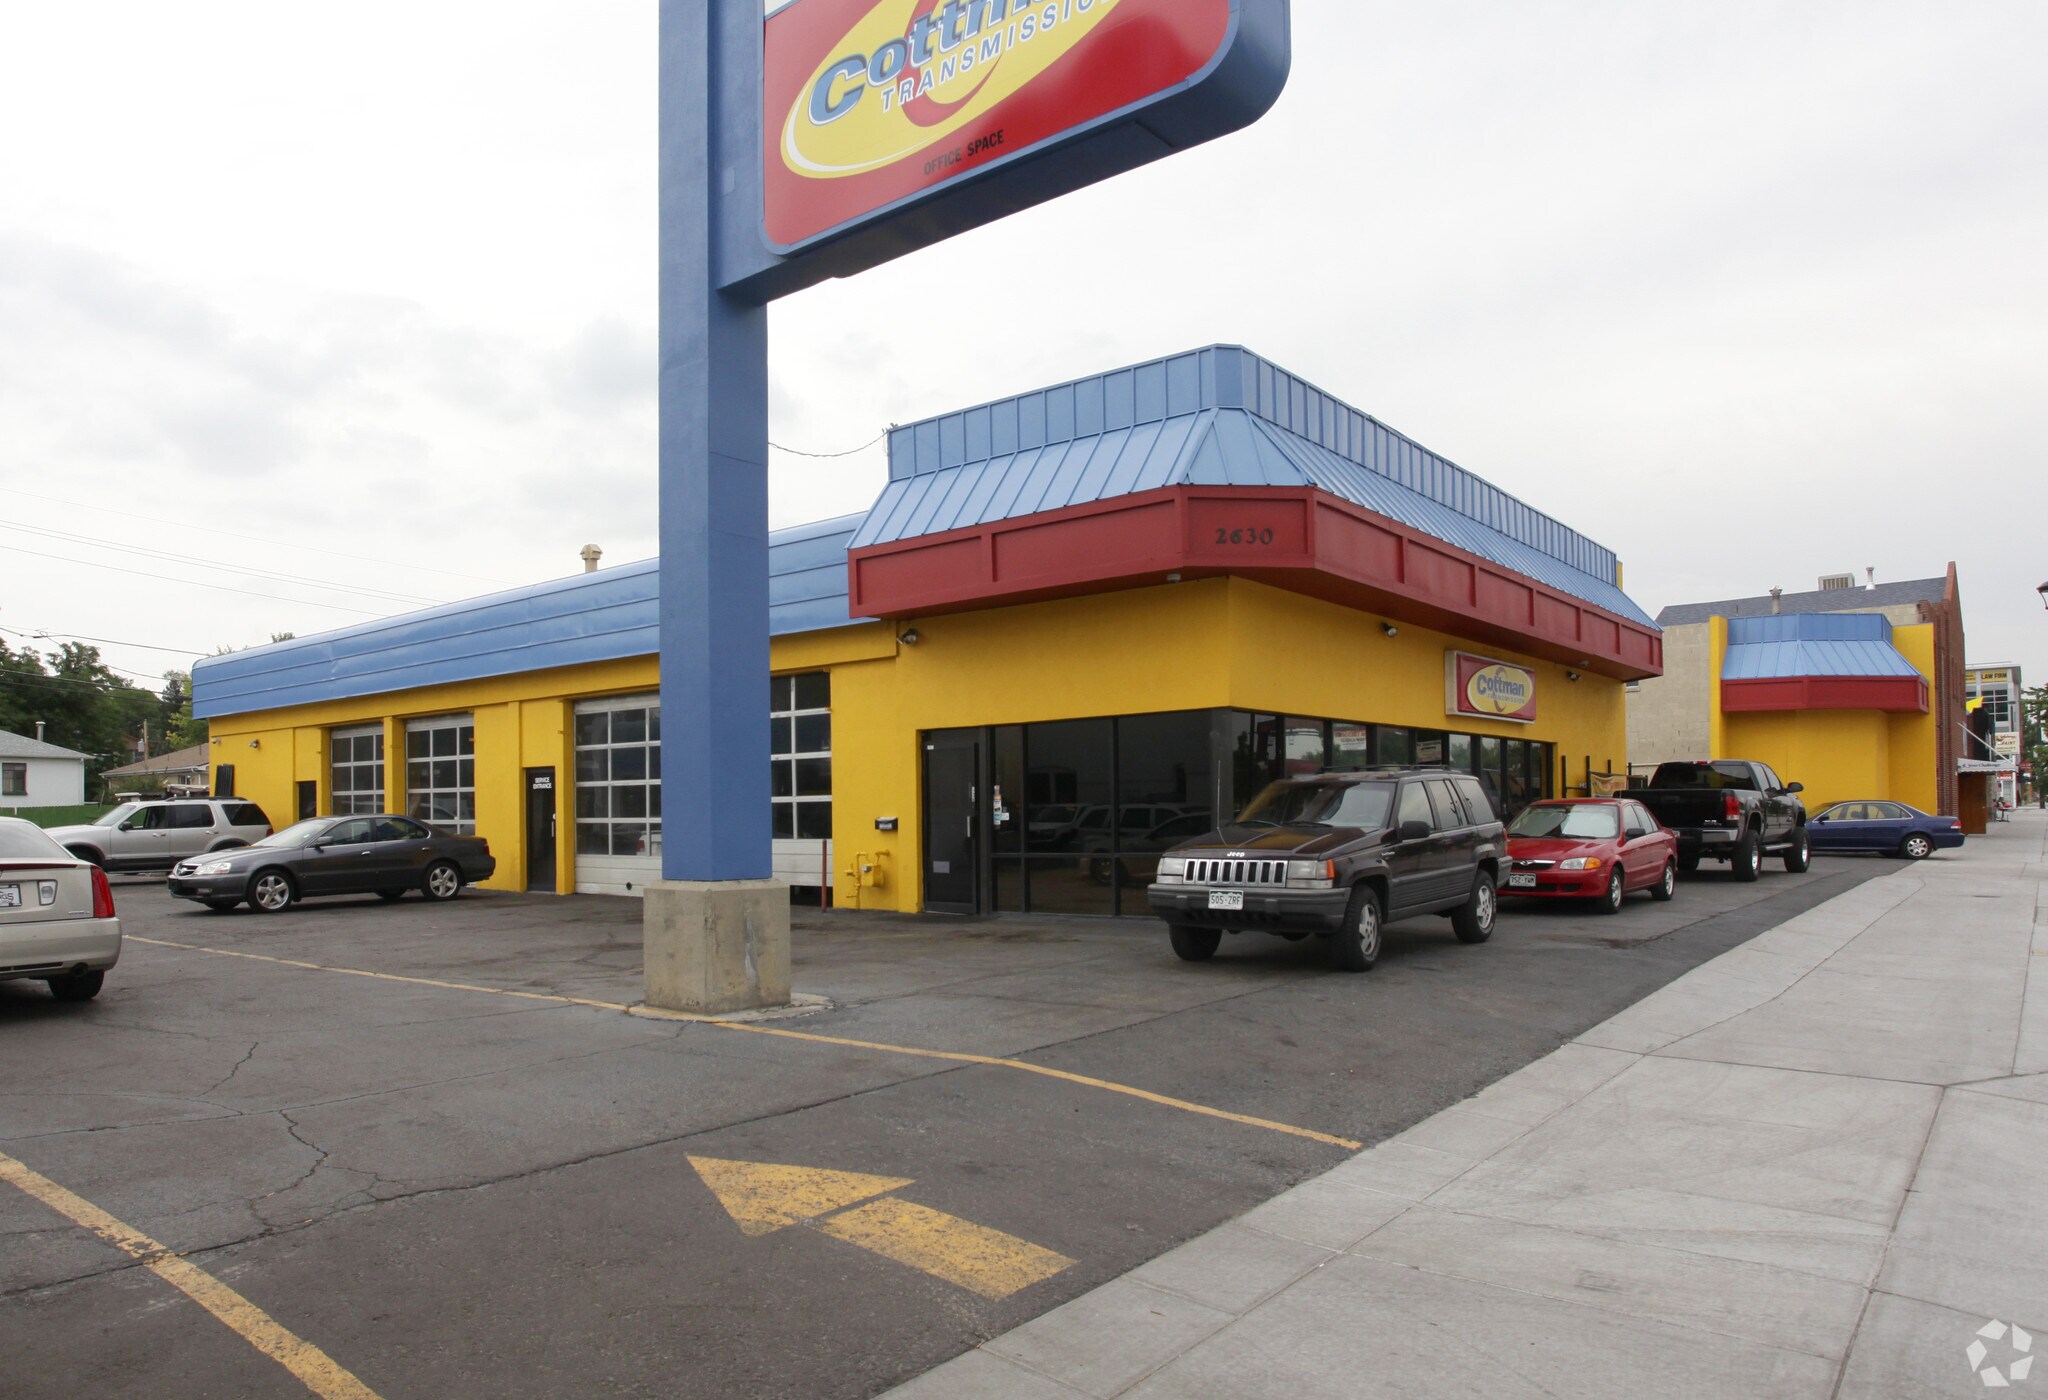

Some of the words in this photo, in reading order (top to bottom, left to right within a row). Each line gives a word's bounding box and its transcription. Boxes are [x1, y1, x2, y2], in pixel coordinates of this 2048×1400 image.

[807, 0, 1046, 127] Cottm
[924, 148, 962, 176] OFFICE
[966, 129, 1005, 157] SPACE
[1215, 527, 1274, 545] 2630
[1476, 674, 1525, 696] Cottman
[1981, 672, 1993, 680] LAW
